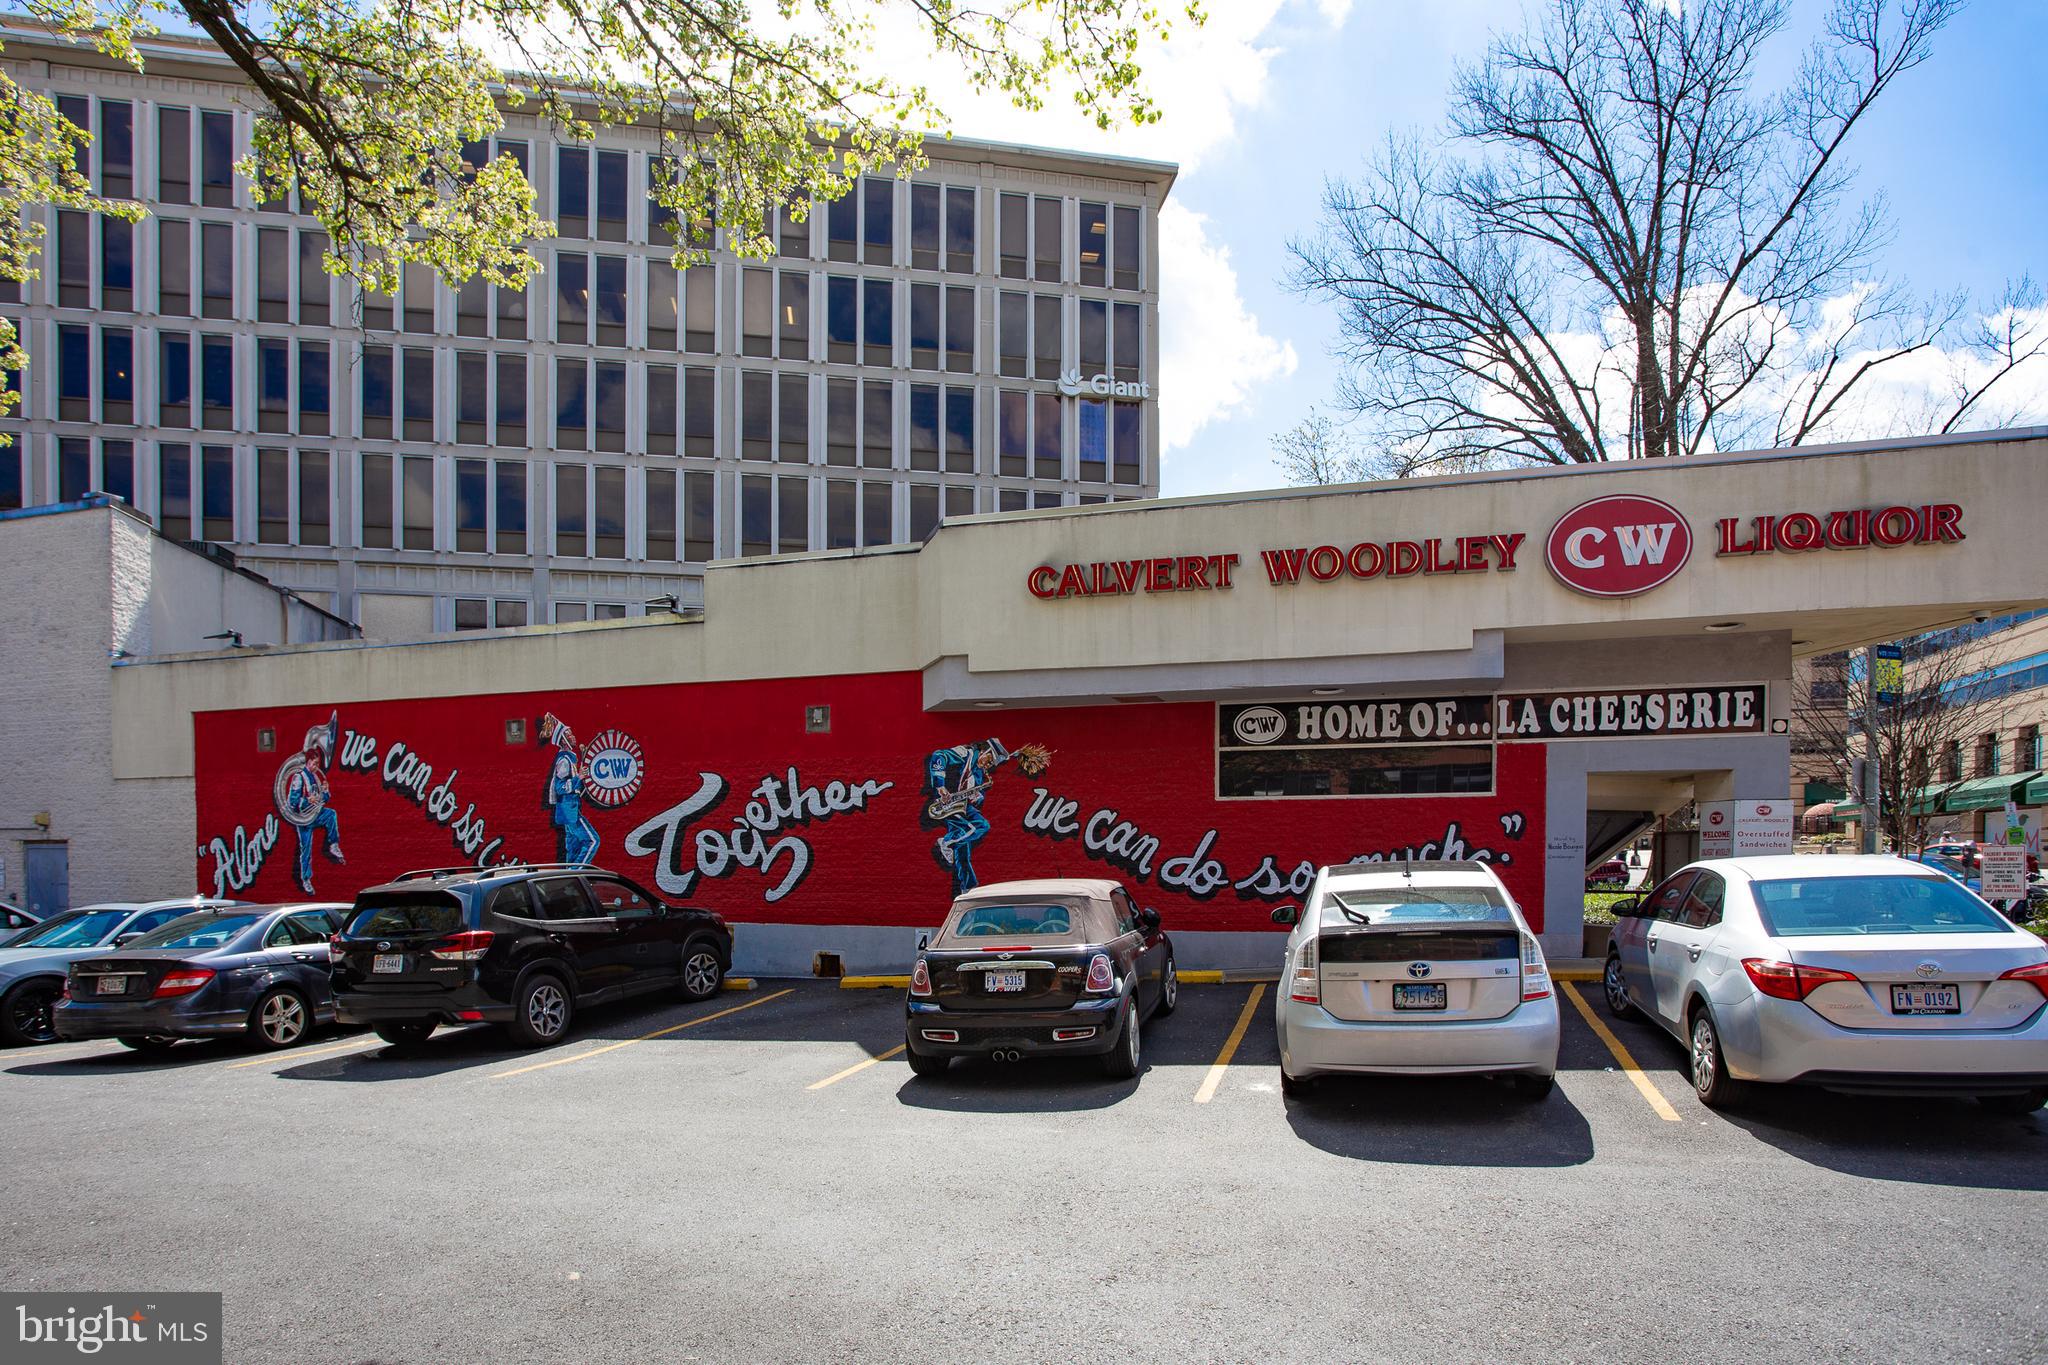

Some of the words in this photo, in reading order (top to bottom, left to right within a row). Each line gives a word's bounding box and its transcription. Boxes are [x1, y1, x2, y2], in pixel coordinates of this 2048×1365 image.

[1090, 374, 1149, 398] Giant
[1027, 553, 1240, 600] CALVERT
[1260, 533, 1526, 586] WOODLEY
[1715, 504, 1966, 558] LIQUOR
[1297, 704, 1402, 739] HOME
[1498, 699, 1541, 734] LA
[1550, 691, 1754, 732] CHEESERIE
[594, 757, 631, 780] CW
[625, 766, 895, 902] Together
[1160, 829, 1228, 894] do
[1234, 857, 1326, 895] so
[918, 935, 927, 950] 4
[1004, 976, 1023, 986] 5315
[1897, 992, 1912, 1006] FN
[1924, 992, 1953, 1006] 0192
